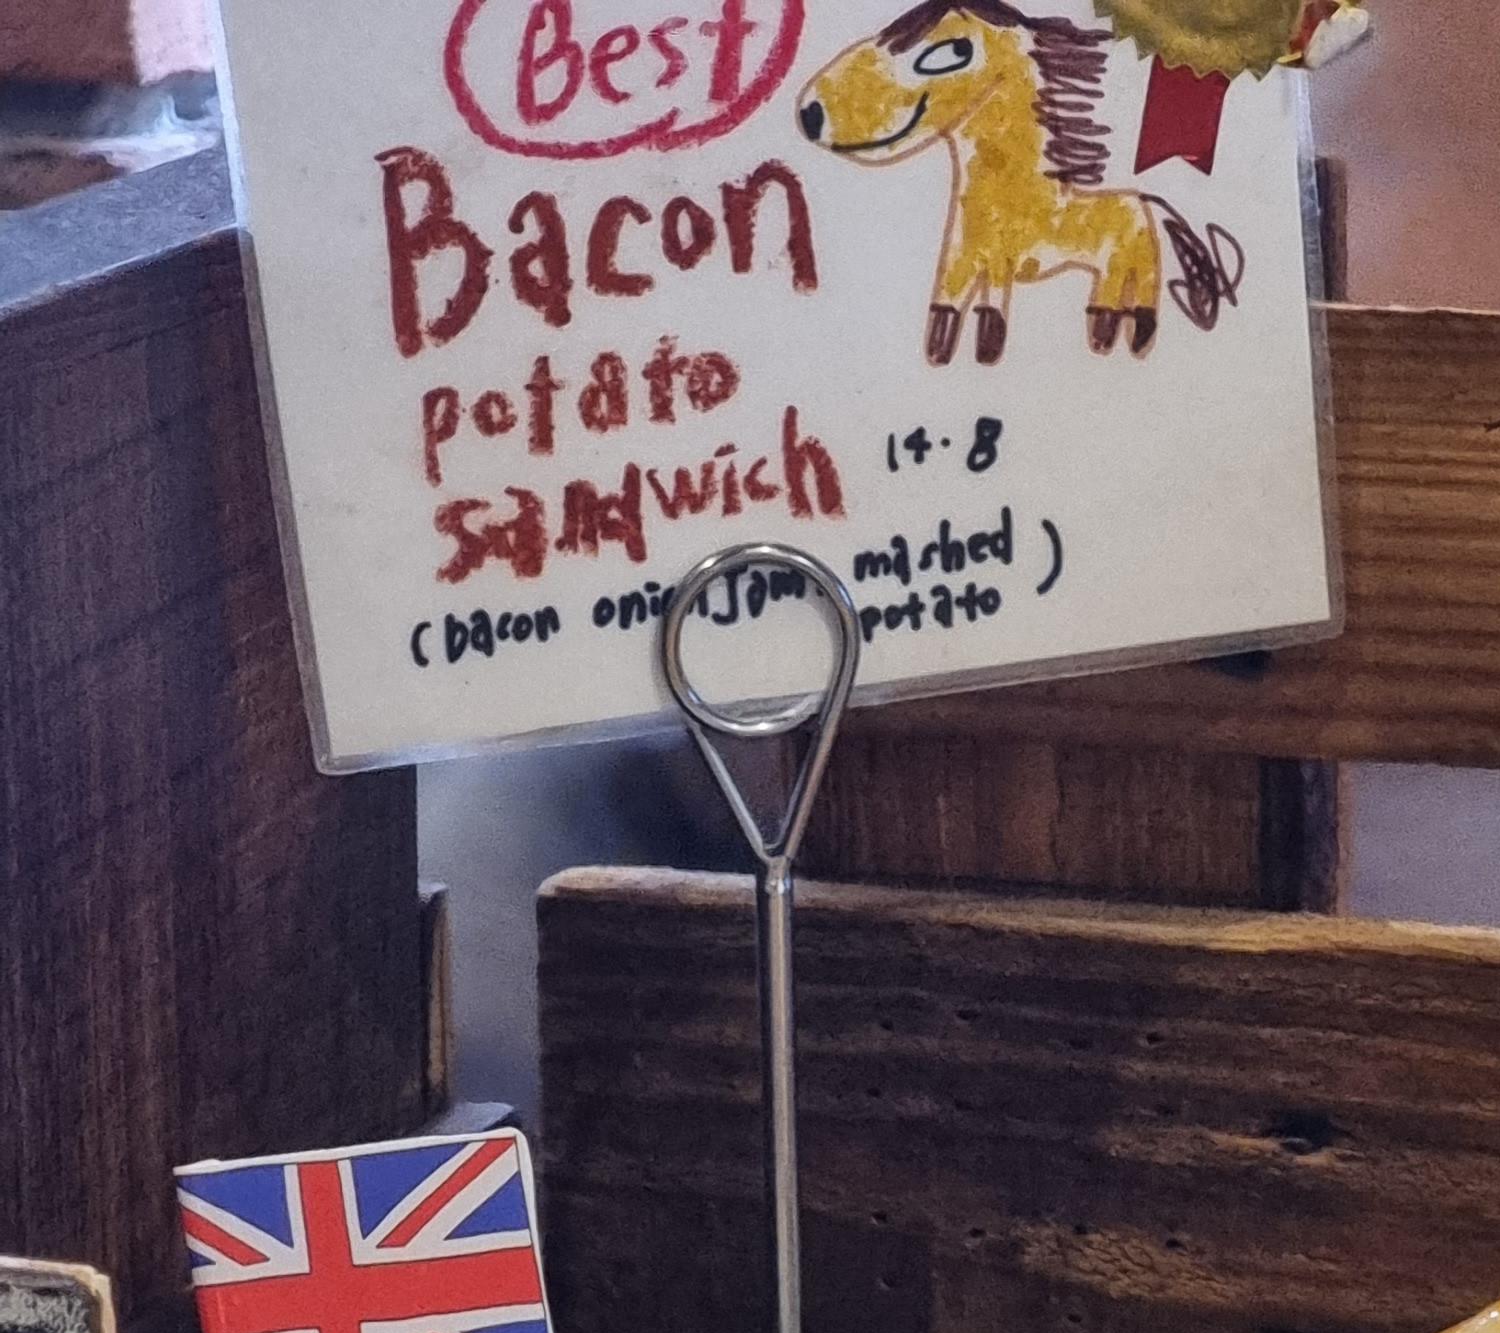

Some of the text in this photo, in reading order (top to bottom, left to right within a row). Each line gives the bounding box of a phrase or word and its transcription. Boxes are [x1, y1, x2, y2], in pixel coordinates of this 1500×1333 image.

[515, 0, 759, 126] Best
[374, 146, 819, 358] Bacon
[421, 335, 741, 487] potato
[433, 404, 846, 584] sandwich
[859, 581, 1002, 643] potato
